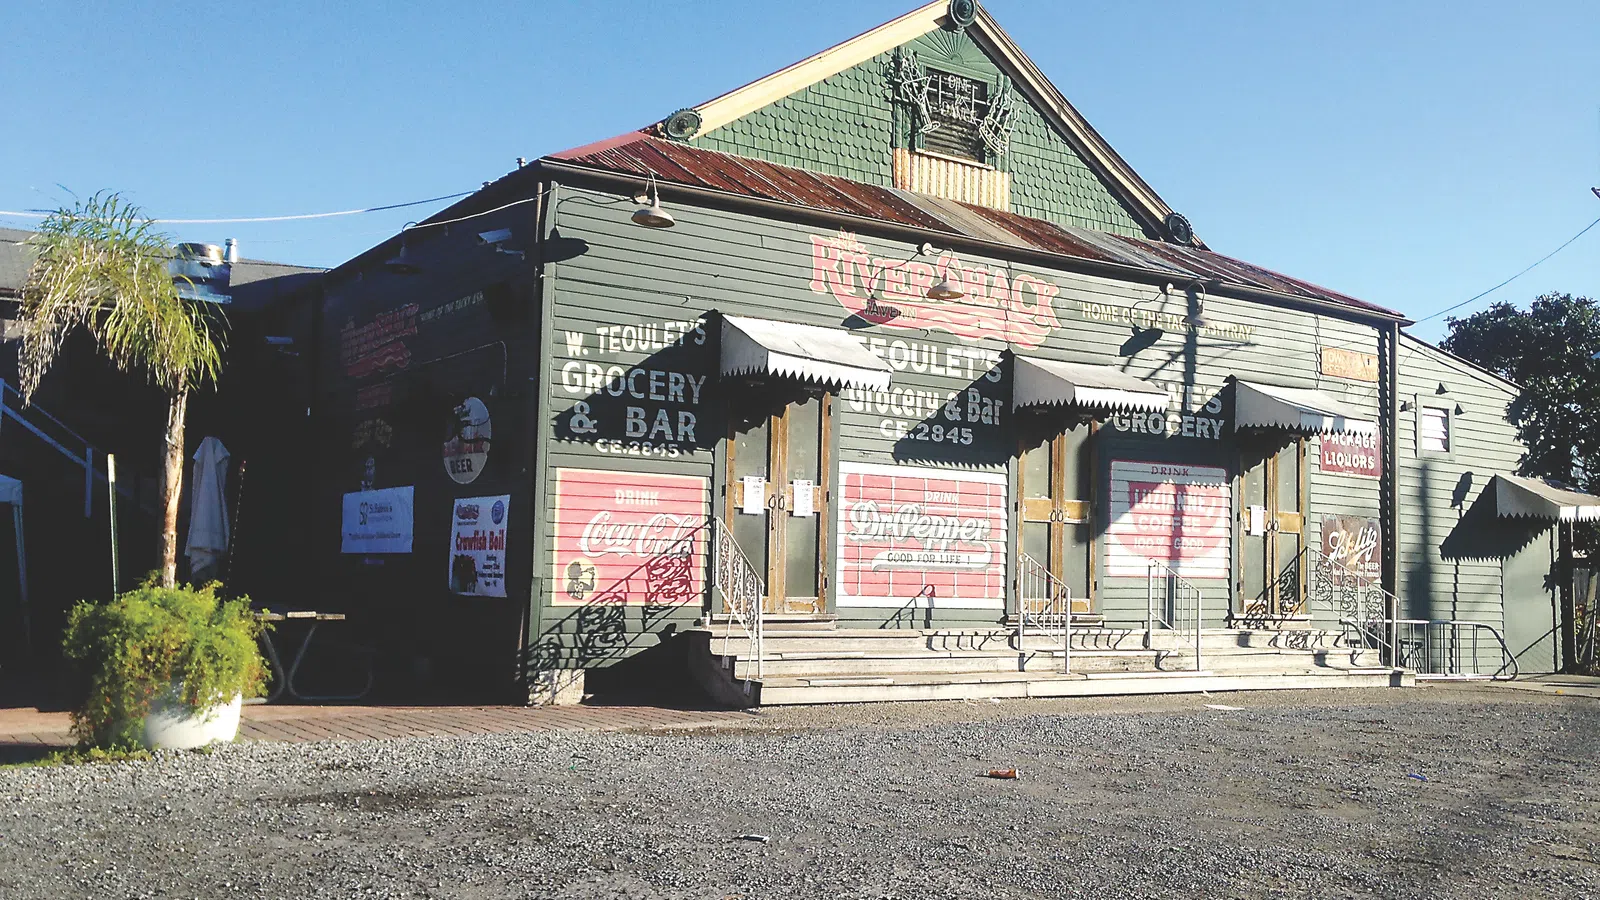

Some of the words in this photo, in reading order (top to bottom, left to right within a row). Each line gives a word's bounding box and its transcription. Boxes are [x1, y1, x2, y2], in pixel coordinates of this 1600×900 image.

[1122, 308, 1138, 323] OF
[1141, 311, 1164, 329] THE
[564, 330, 589, 357] W.
[596, 318, 707, 354] TEOULET'S
[561, 361, 706, 405] GROCERY
[848, 386, 939, 419] Grocery
[943, 391, 962, 421] &
[967, 387, 1004, 426] Bar
[569, 400, 598, 434] &
[625, 406, 697, 443] BAR
[1112, 412, 1225, 440] GROCERY
[450, 458, 473, 474] BEER
[1324, 451, 1376, 470] LIQUORS
[1151, 465, 1190, 477] DRINK
[614, 489, 661, 506] DRINK
[925, 491, 959, 504] DRINK
[1134, 488, 1206, 514] LUZIANNE
[1138, 515, 1202, 533] COFFEE
[488, 529, 504, 551] Boil
[1173, 538, 1205, 550] GOOD
[1328, 526, 1378, 565] Schlitz
[887, 552, 913, 564] GOOD
[917, 553, 936, 564] FOR
[940, 554, 961, 565] LIFE
[1364, 561, 1379, 570] BEER
